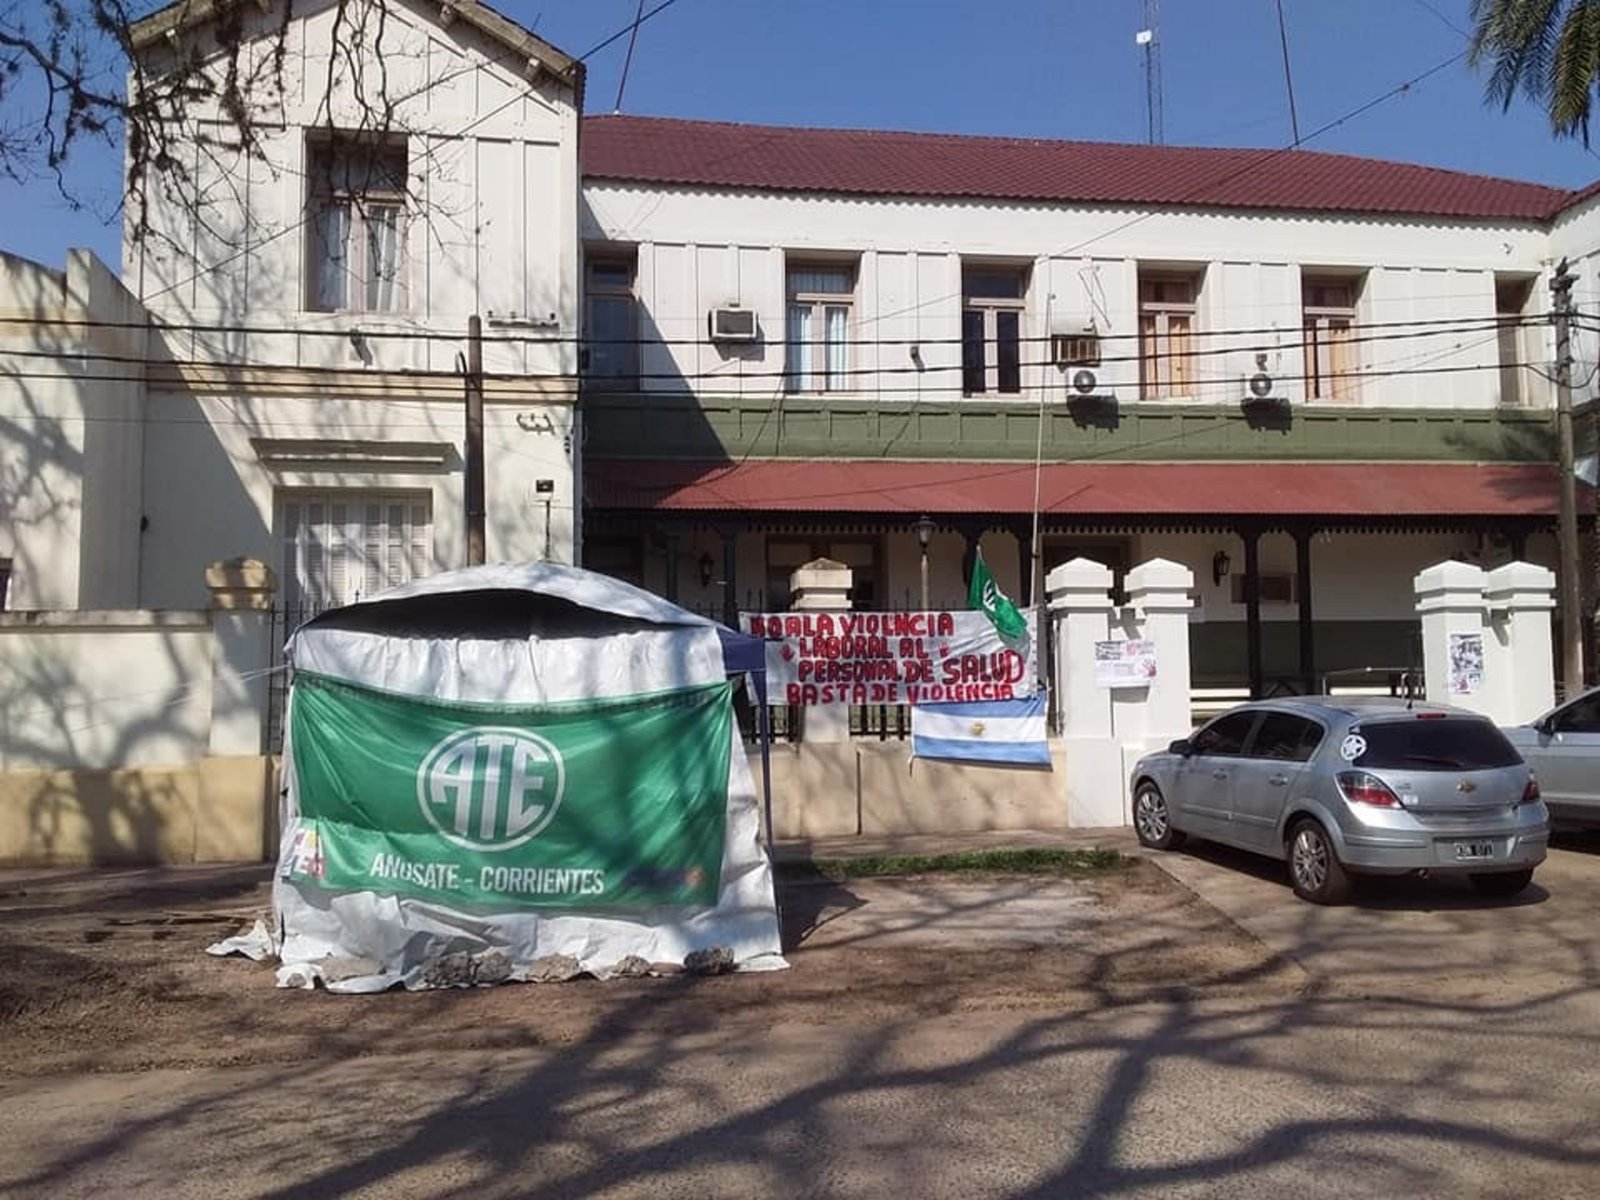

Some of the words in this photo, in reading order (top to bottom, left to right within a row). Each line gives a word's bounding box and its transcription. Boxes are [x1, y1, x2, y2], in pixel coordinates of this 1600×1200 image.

[785, 615, 800, 637] A
[803, 613, 834, 637] LA
[800, 634, 893, 659] LABORAL
[900, 638, 928, 658] AL
[904, 660, 935, 683] DE
[942, 649, 1024, 685] SALUD
[787, 683, 867, 705] BASTA
[871, 683, 897, 702] DE
[907, 683, 1014, 705] VIOLENCIA
[430, 733, 550, 840] ATE
[480, 866, 605, 894] CORRIENTES
